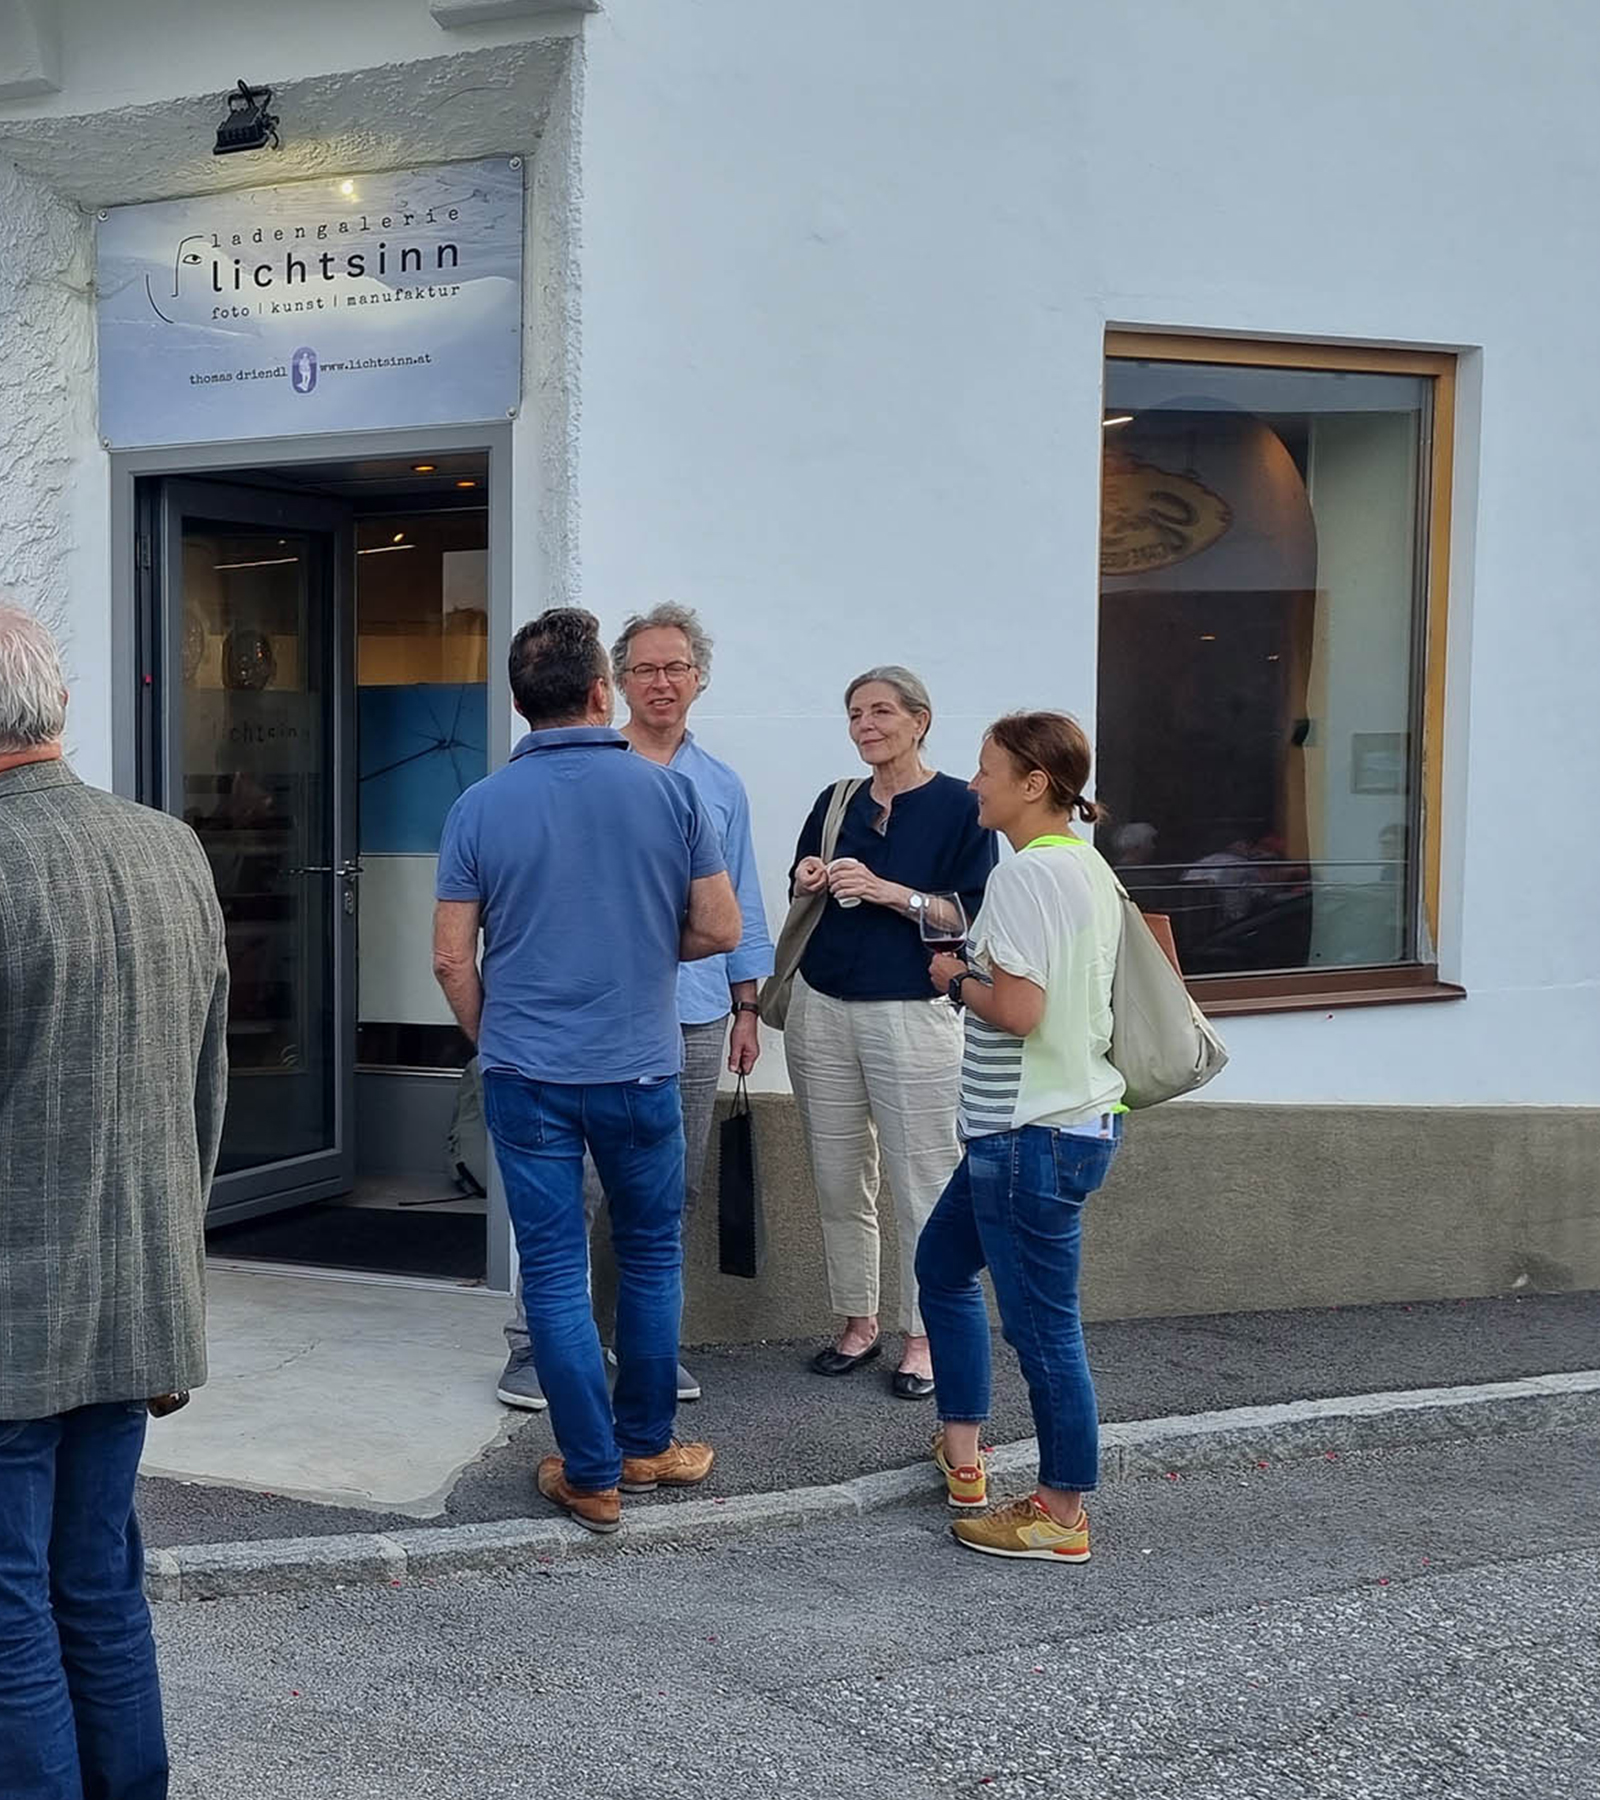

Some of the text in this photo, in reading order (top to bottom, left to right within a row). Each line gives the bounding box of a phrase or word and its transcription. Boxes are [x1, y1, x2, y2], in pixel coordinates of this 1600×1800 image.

[211, 208, 459, 248] ladengalerie
[212, 242, 458, 292] lichtsinn
[211, 306, 250, 320] foto
[271, 298, 324, 313] kunst
[347, 285, 460, 306] manufaktur
[190, 354, 432, 385] thomas driendl www.lichtsinn.at
